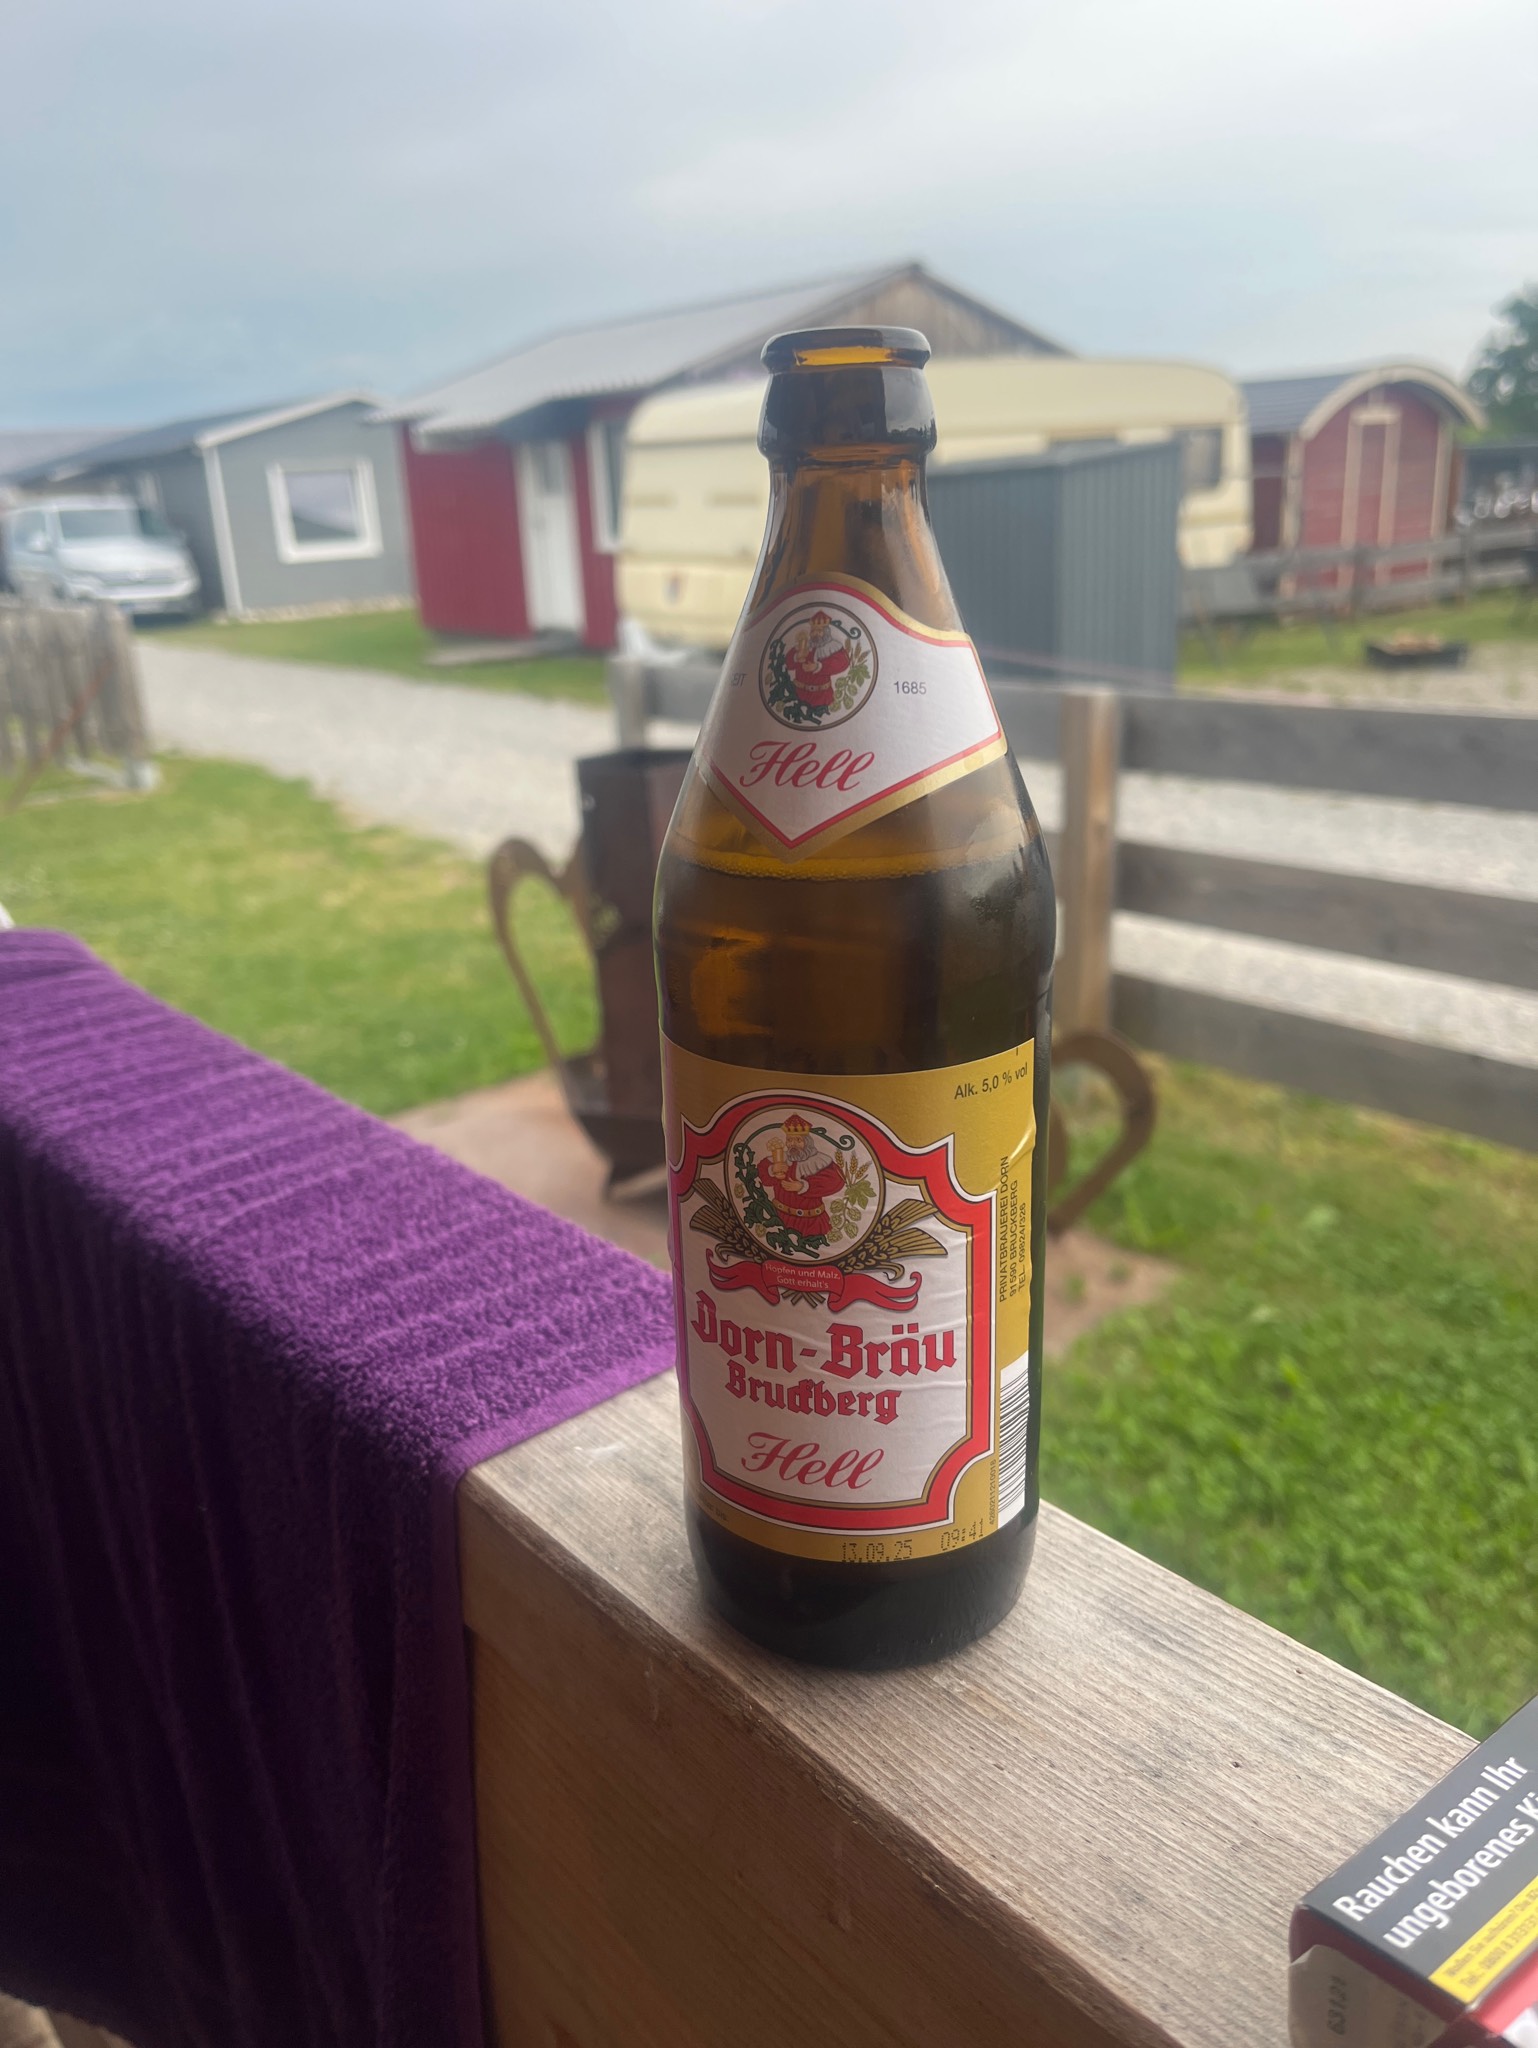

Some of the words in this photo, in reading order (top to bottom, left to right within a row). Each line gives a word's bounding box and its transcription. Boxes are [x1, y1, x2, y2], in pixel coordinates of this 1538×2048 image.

[893, 681, 927, 695] 1685
[739, 741, 875, 792] Hell
[954, 1083, 978, 1100] Alk.
[982, 1075, 999, 1093] 5,0
[1002, 1070, 1012, 1086] %
[1015, 1062, 1028, 1080] vol
[1000, 1156, 1009, 1194] DORN
[1010, 1180, 1018, 1261] BRUCKBERG
[1018, 1202, 1026, 1263] 09824/326
[765, 1263, 796, 1275] Hopfen
[798, 1269, 815, 1278] und
[1000, 1196, 1008, 1302] PRIVATBRAUEREI
[776, 1275, 795, 1285] Gott
[724, 1359, 903, 1425] Bruckberg
[740, 1431, 885, 1490] Hell
[841, 1538, 913, 1563] 13.09.25
[940, 1518, 984, 1552] 09:41
[1332, 1831, 1448, 1922] Rauchen
[1425, 1785, 1501, 1839] kann
[1480, 1755, 1528, 1791] Ihr
[1383, 1817, 1535, 1949] ungeborenes
[1514, 1791, 1538, 1821] K
